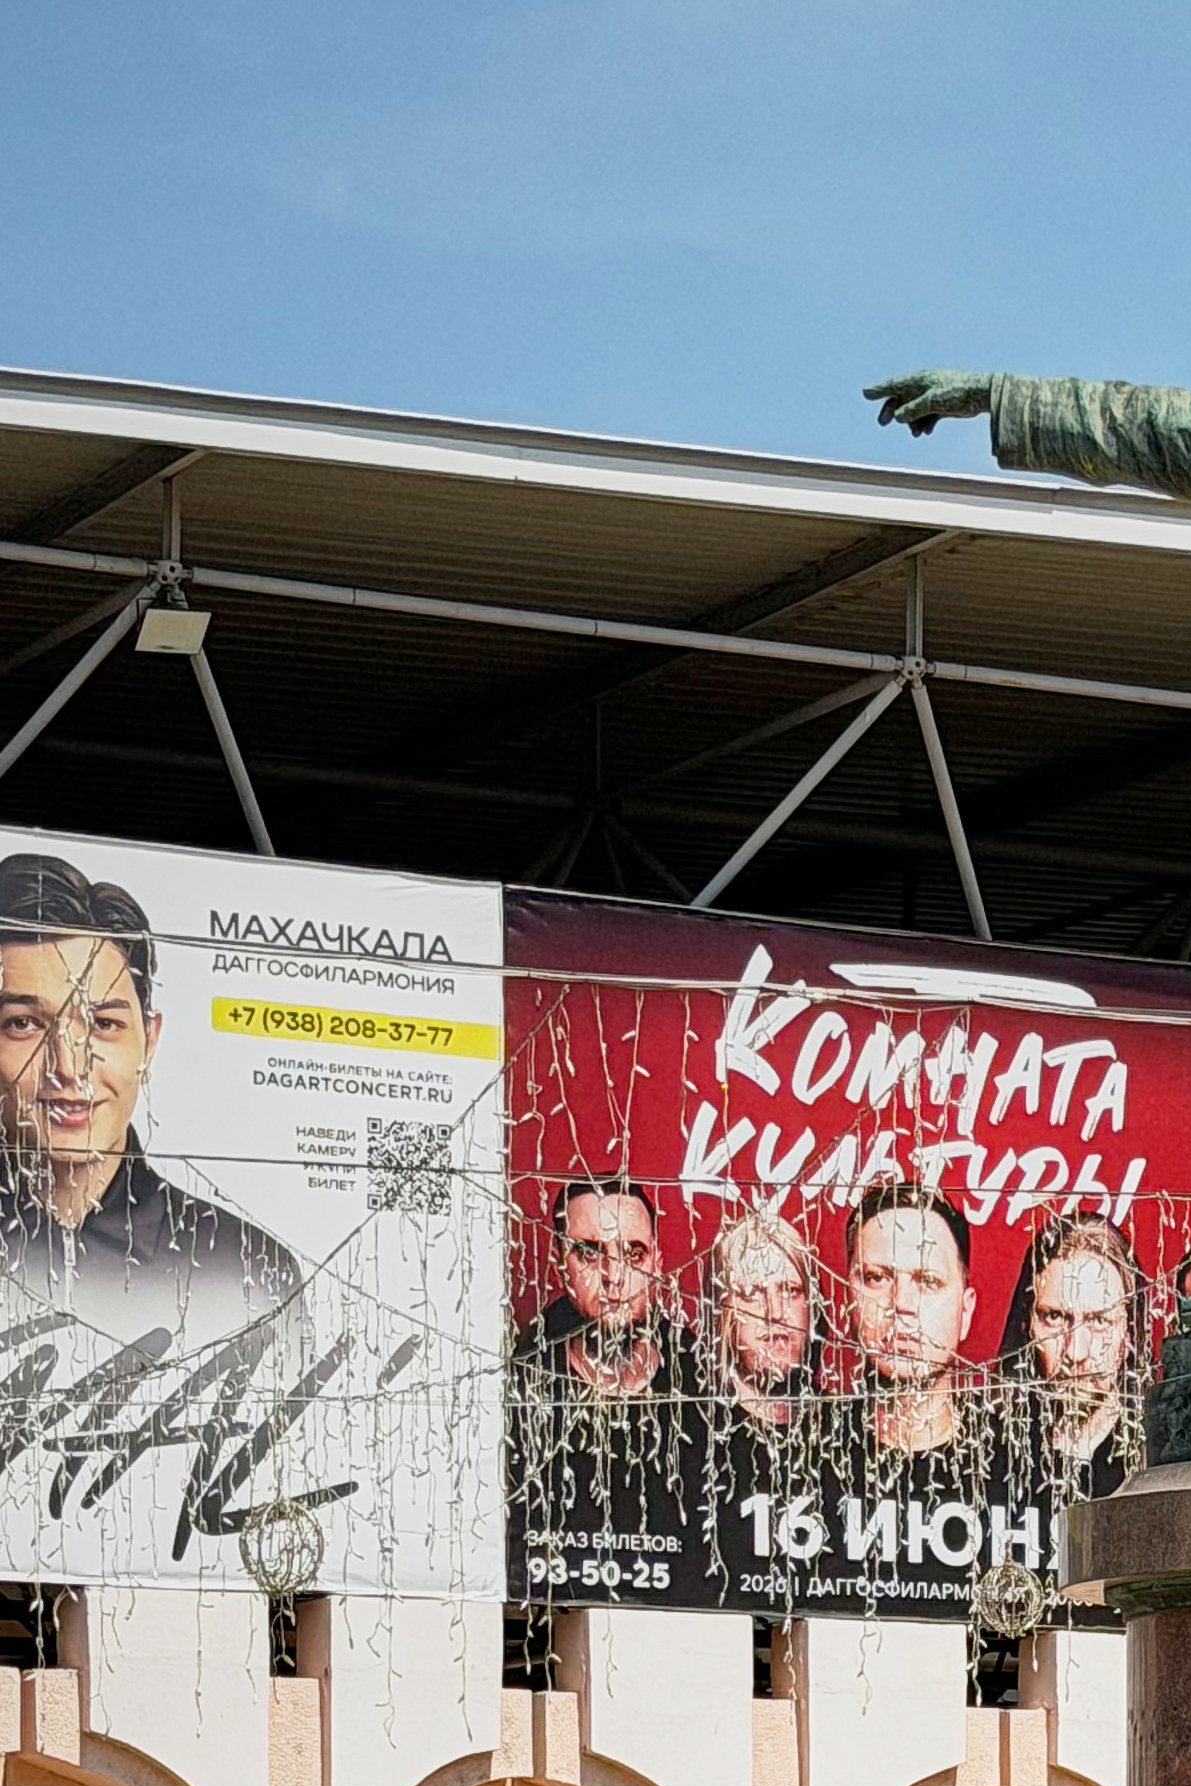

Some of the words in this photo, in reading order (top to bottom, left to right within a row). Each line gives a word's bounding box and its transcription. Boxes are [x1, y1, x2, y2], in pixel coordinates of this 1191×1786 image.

[209, 909, 453, 962] МАХАЧКАЛА
[212, 953, 455, 995] ДАГГОСФИЛАРМОНИЯ
[229, 1007, 255, 1026] +7
[262, 1007, 323, 1038] (938)
[330, 1016, 453, 1046] 208-37-77
[253, 1070, 453, 1104] DAGARTCONCERT.RU
[267, 1056, 382, 1078] ОНЛАЙН-БИЛЕТЫ
[387, 1068, 404, 1079] НА
[408, 1070, 453, 1085] САЙТЕ:
[296, 1126, 356, 1141] НАВЕДИ
[308, 1176, 356, 1191] БИЛЕТ
[527, 1530, 589, 1549] ЗАКАЗ
[592, 1533, 682, 1553] БИЛЕТОВ:
[741, 1493, 823, 1559] 16
[846, 1498, 1059, 1569] ИЮН
[529, 1557, 671, 1589] 93-50-25
